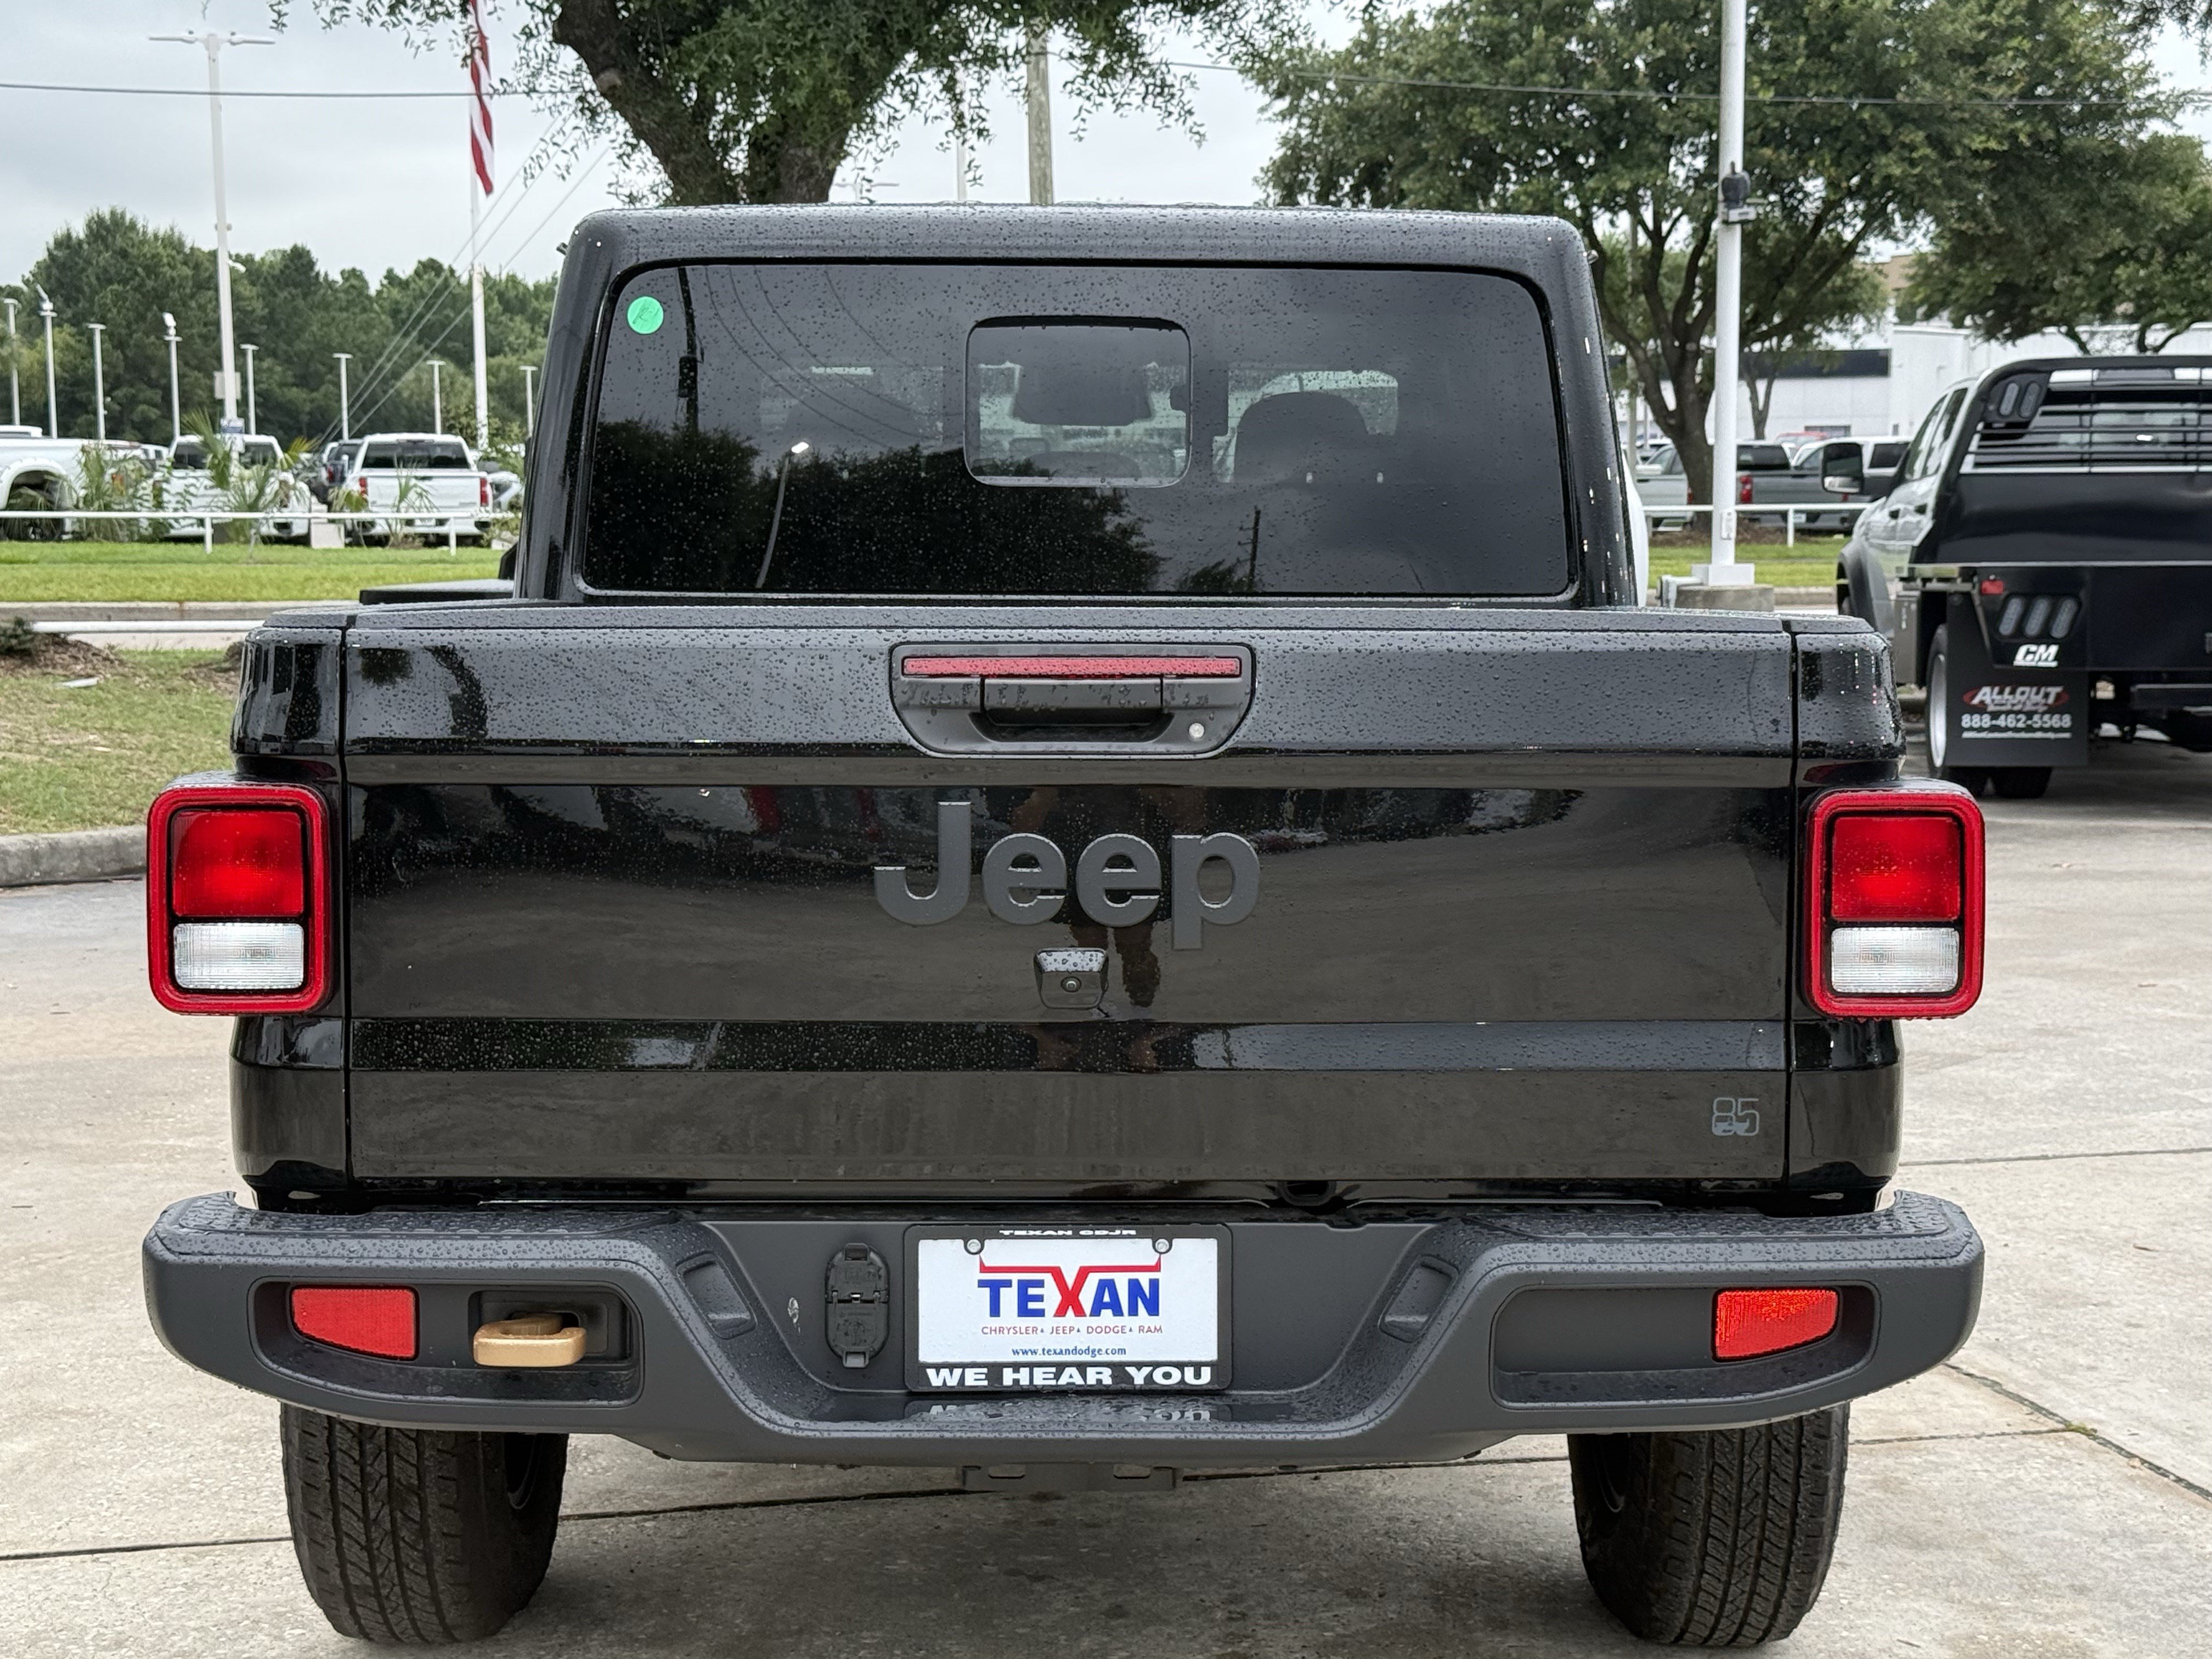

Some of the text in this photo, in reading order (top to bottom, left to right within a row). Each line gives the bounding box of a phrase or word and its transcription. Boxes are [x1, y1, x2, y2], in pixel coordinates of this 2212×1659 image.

[873, 801, 1261, 950] Jeep
[1712, 1097, 1760, 1136] 85
[977, 1266, 1160, 1317] TEXAN
[981, 1325, 1163, 1335] CHRYSLER JEEP DODGE RAM
[1012, 1346, 1126, 1358] www.texandodge.com
[926, 1366, 1212, 1386] WE HEAR YOU
